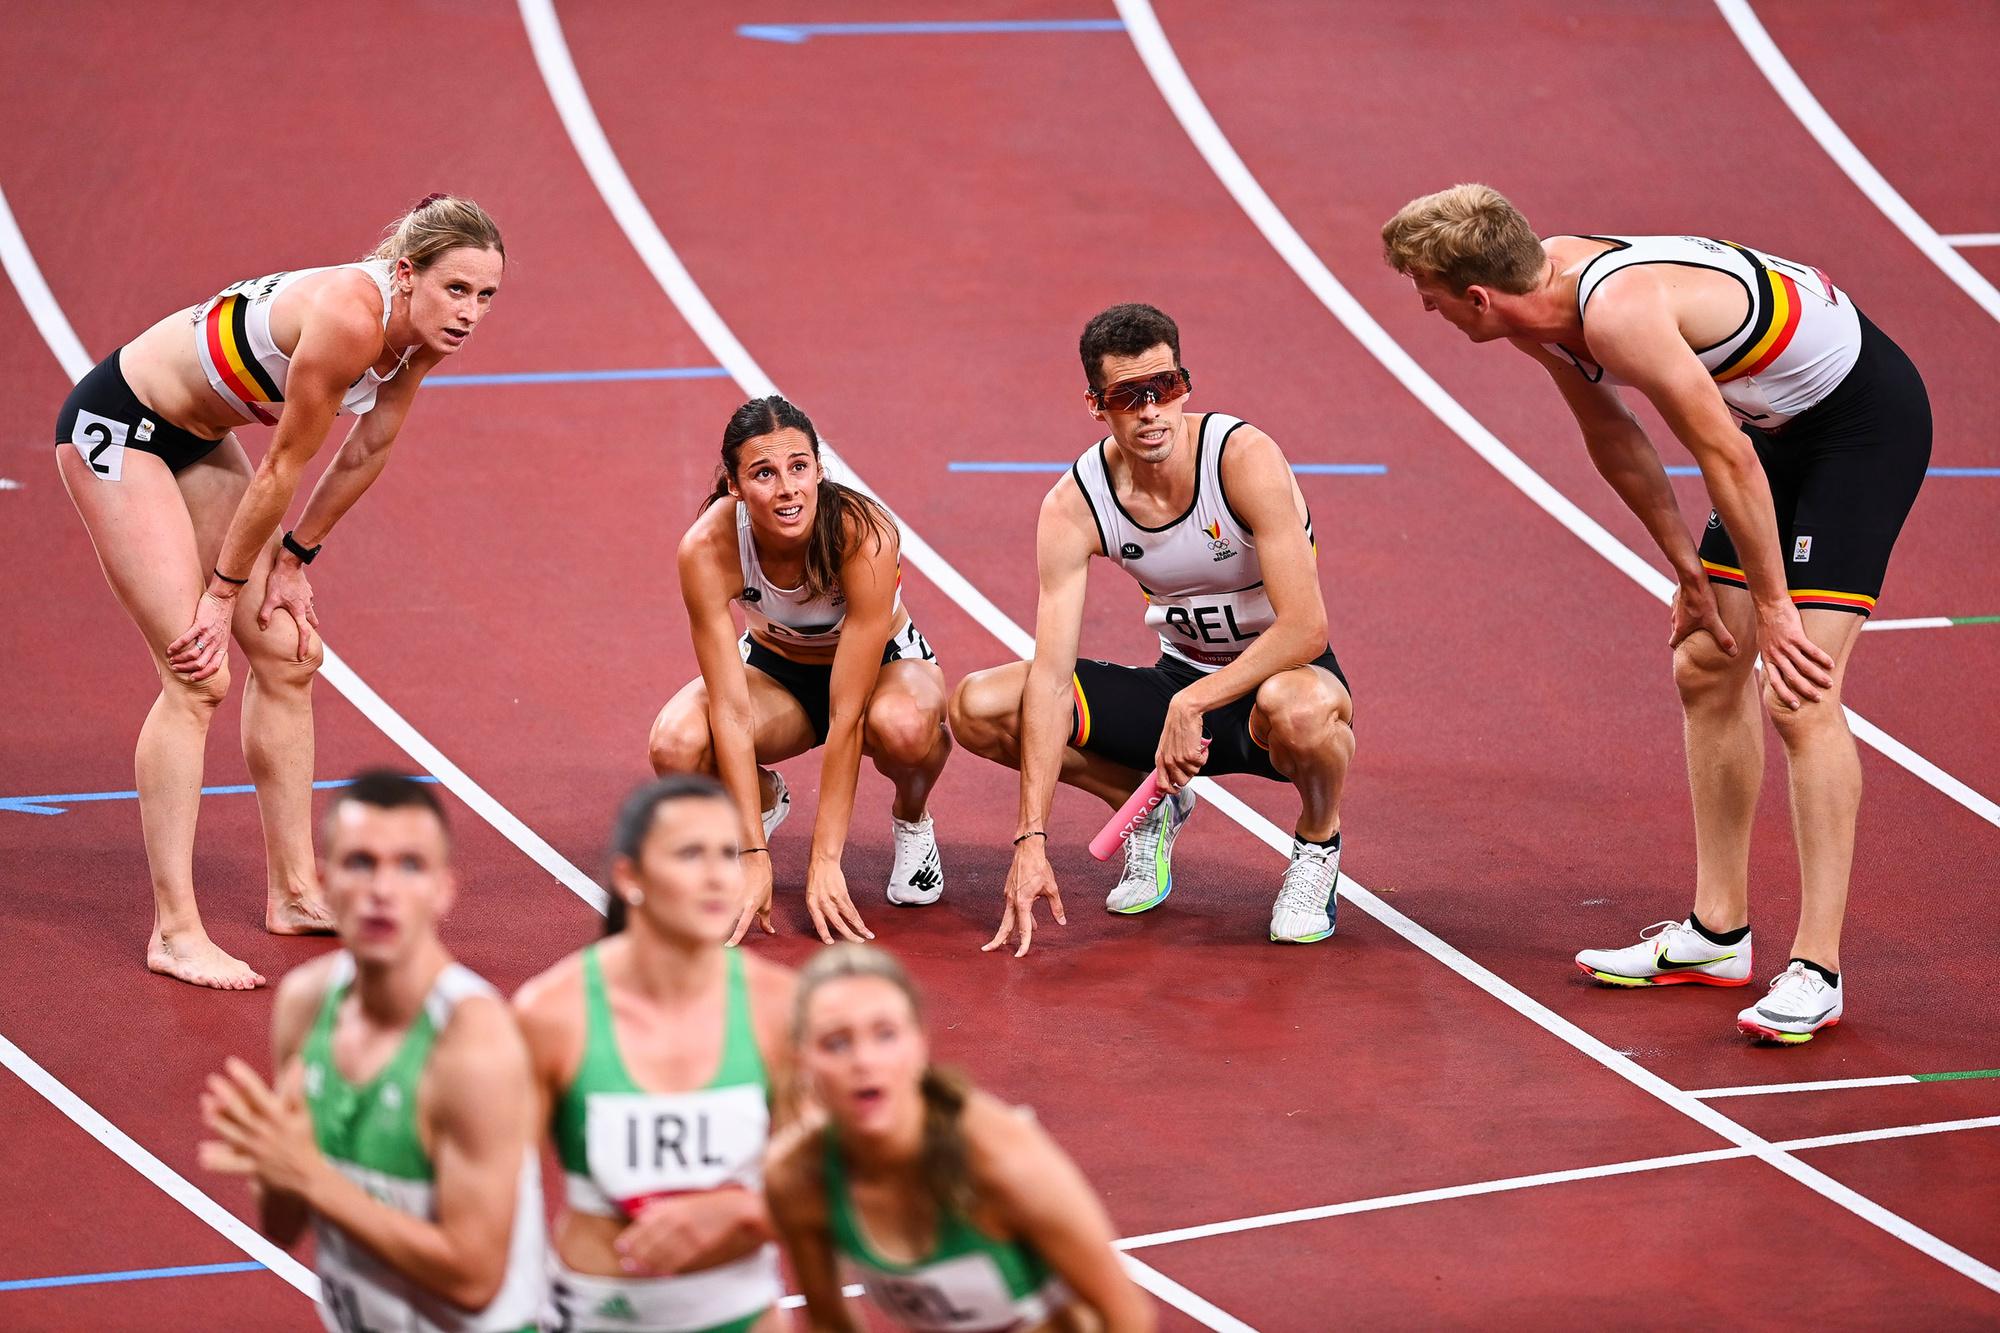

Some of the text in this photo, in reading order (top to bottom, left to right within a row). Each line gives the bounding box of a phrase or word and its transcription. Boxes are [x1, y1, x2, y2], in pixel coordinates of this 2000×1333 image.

[83, 422, 113, 474] 2
[1166, 604, 1260, 643] BEL
[627, 1113, 724, 1169] IRL
